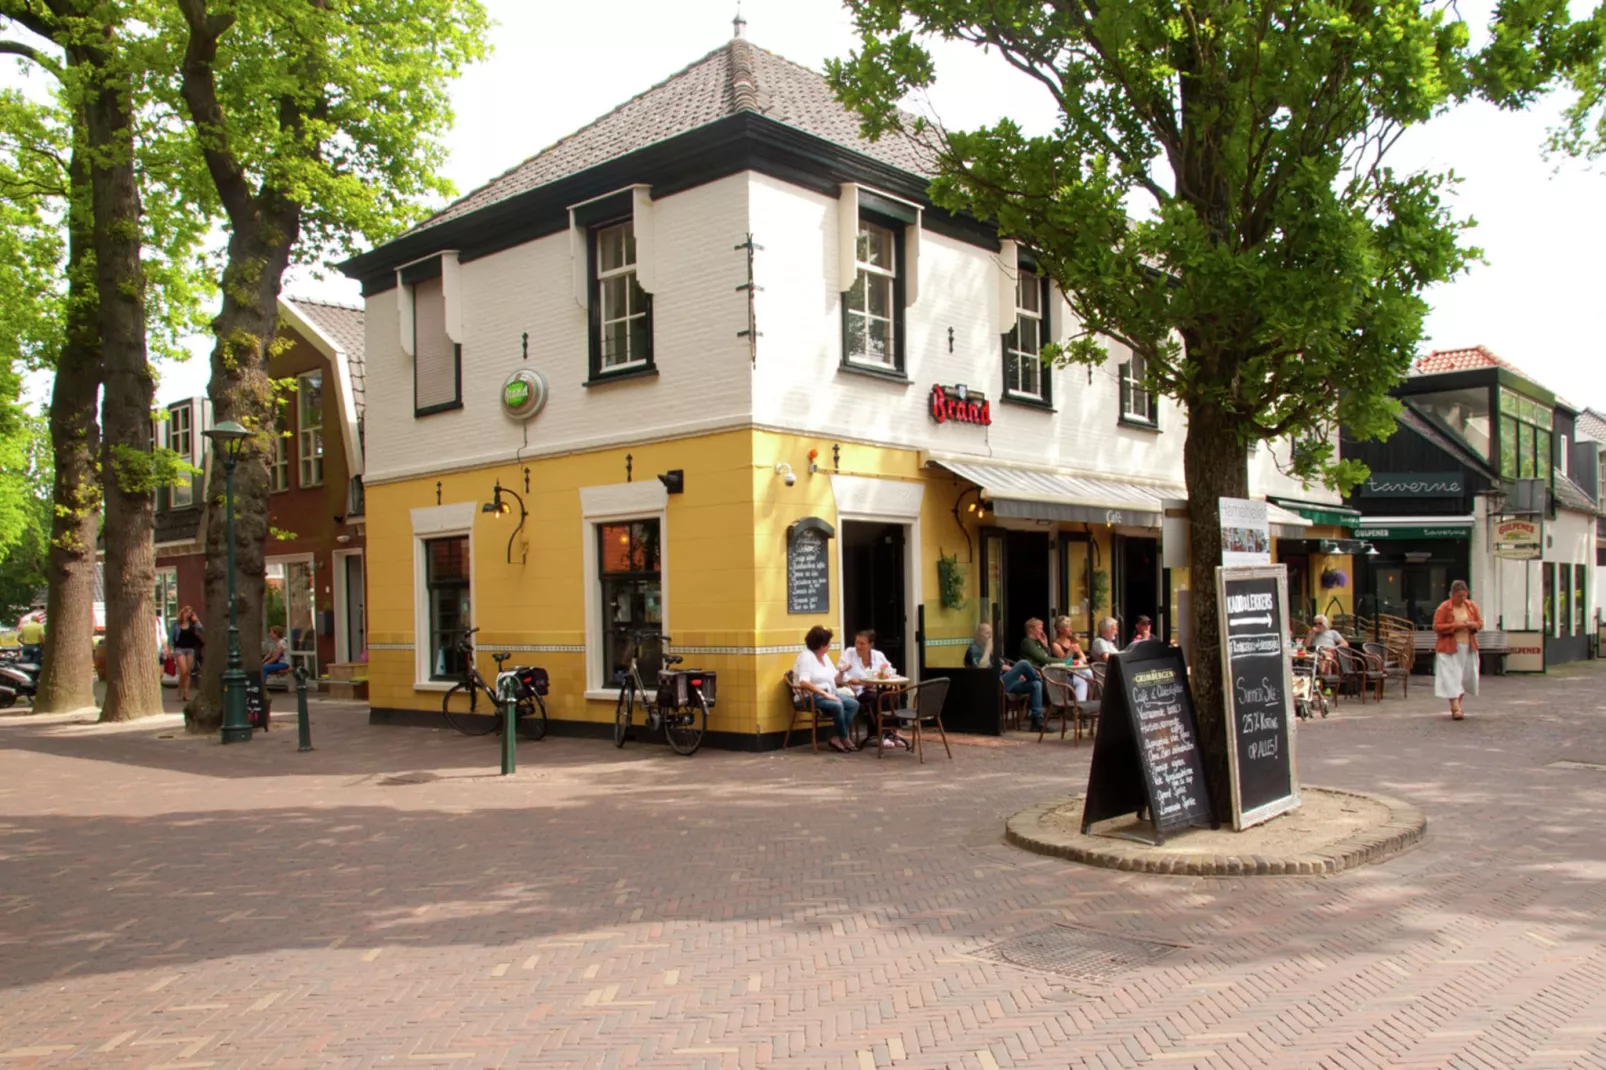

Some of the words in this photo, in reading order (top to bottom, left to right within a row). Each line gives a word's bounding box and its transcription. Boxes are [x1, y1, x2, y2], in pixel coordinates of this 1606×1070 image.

[1367, 476, 1461, 493] taverne
[1354, 529, 1389, 538] GULPENER
[1498, 522, 1534, 535] GULPENER
